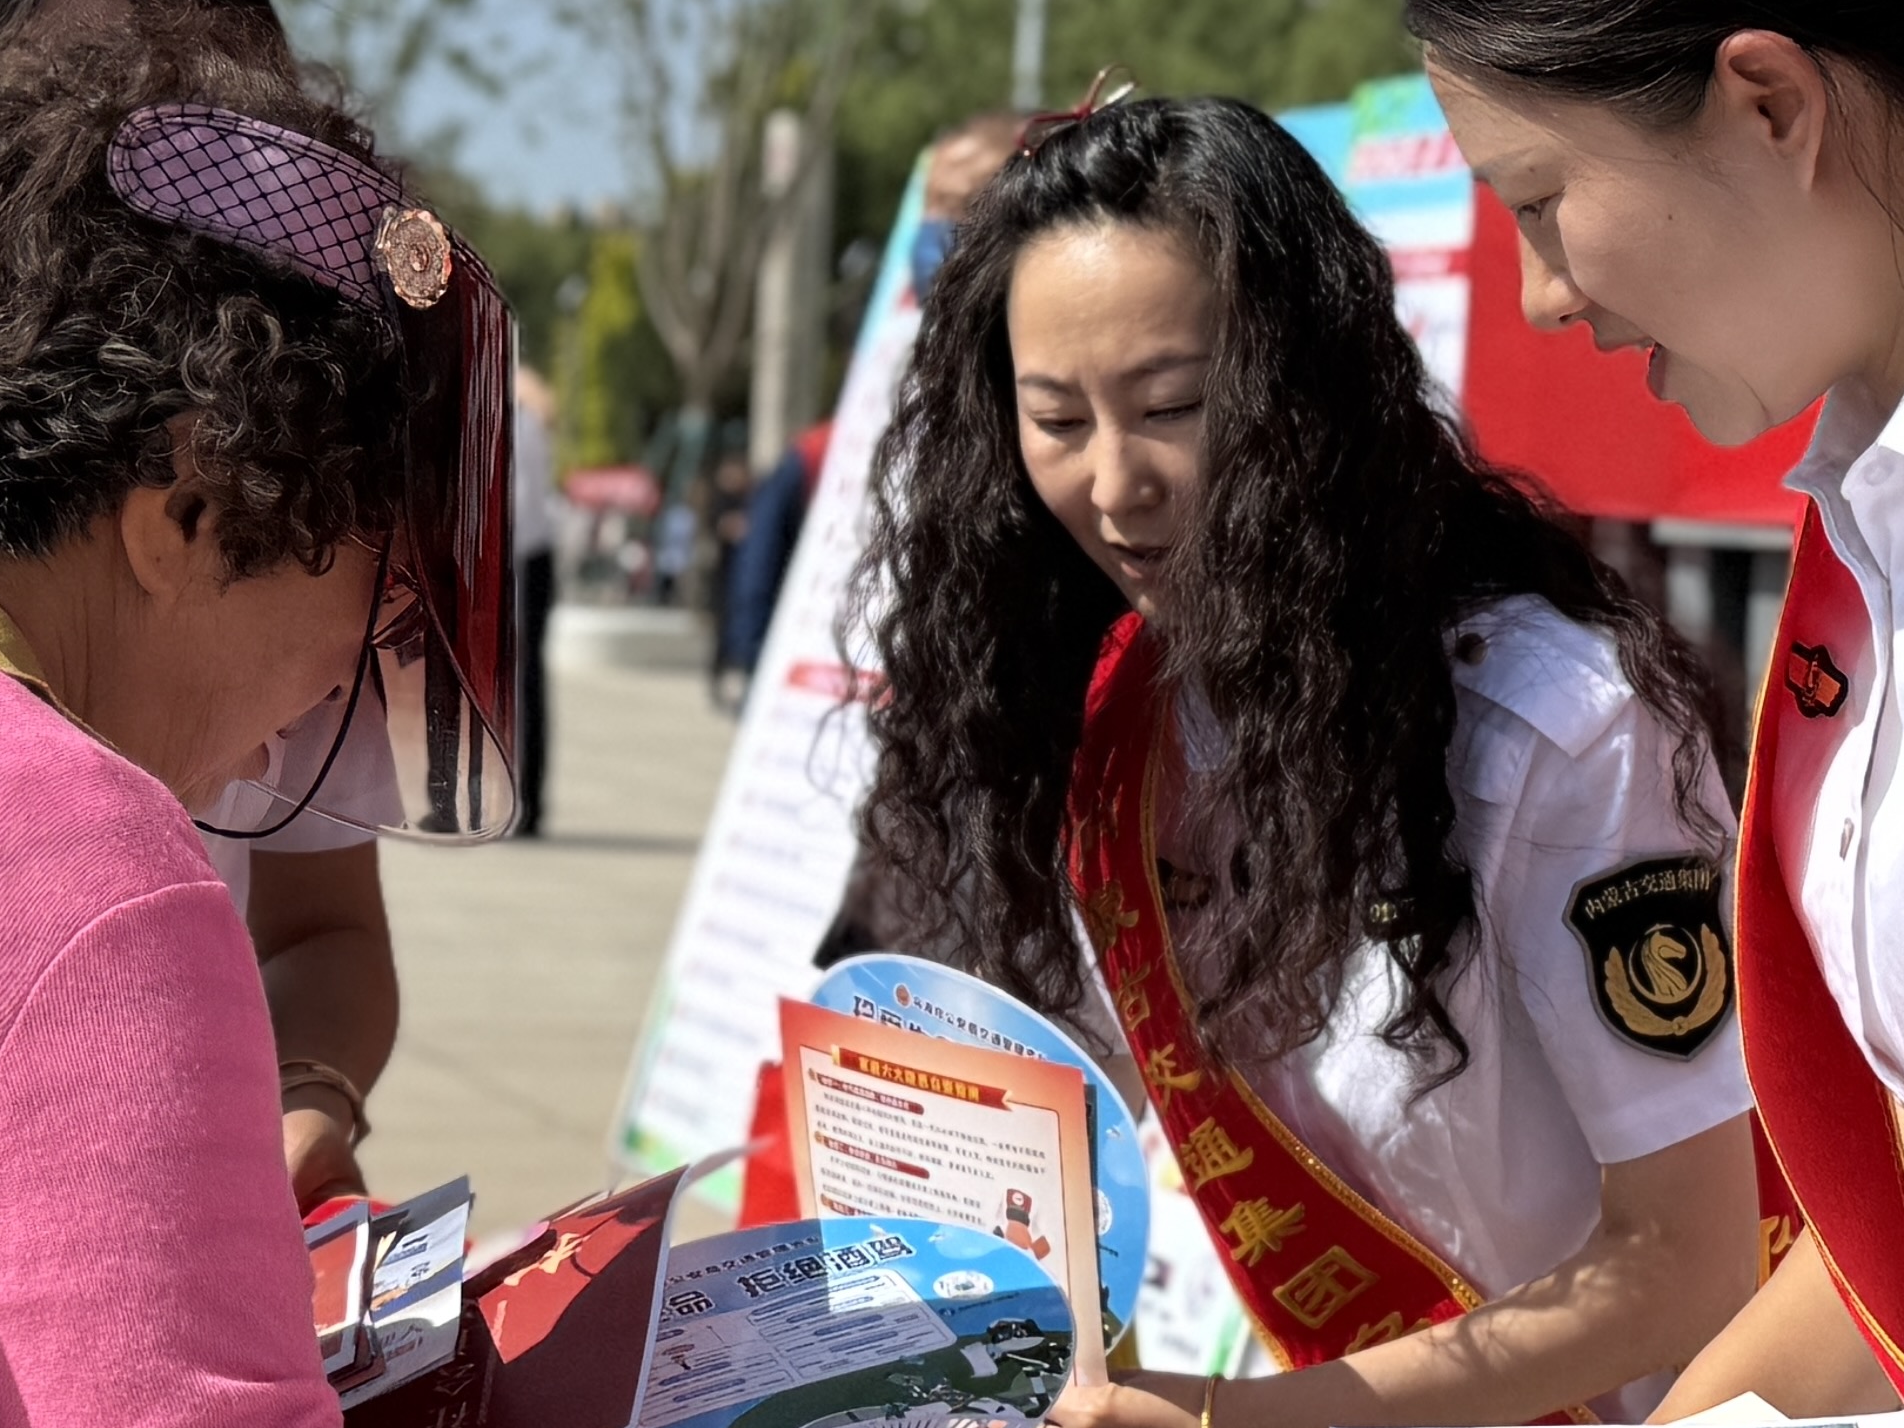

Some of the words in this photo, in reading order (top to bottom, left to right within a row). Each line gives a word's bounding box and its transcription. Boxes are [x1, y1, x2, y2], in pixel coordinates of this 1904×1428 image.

[1584, 868, 1712, 920] 内蒙古交通集团
